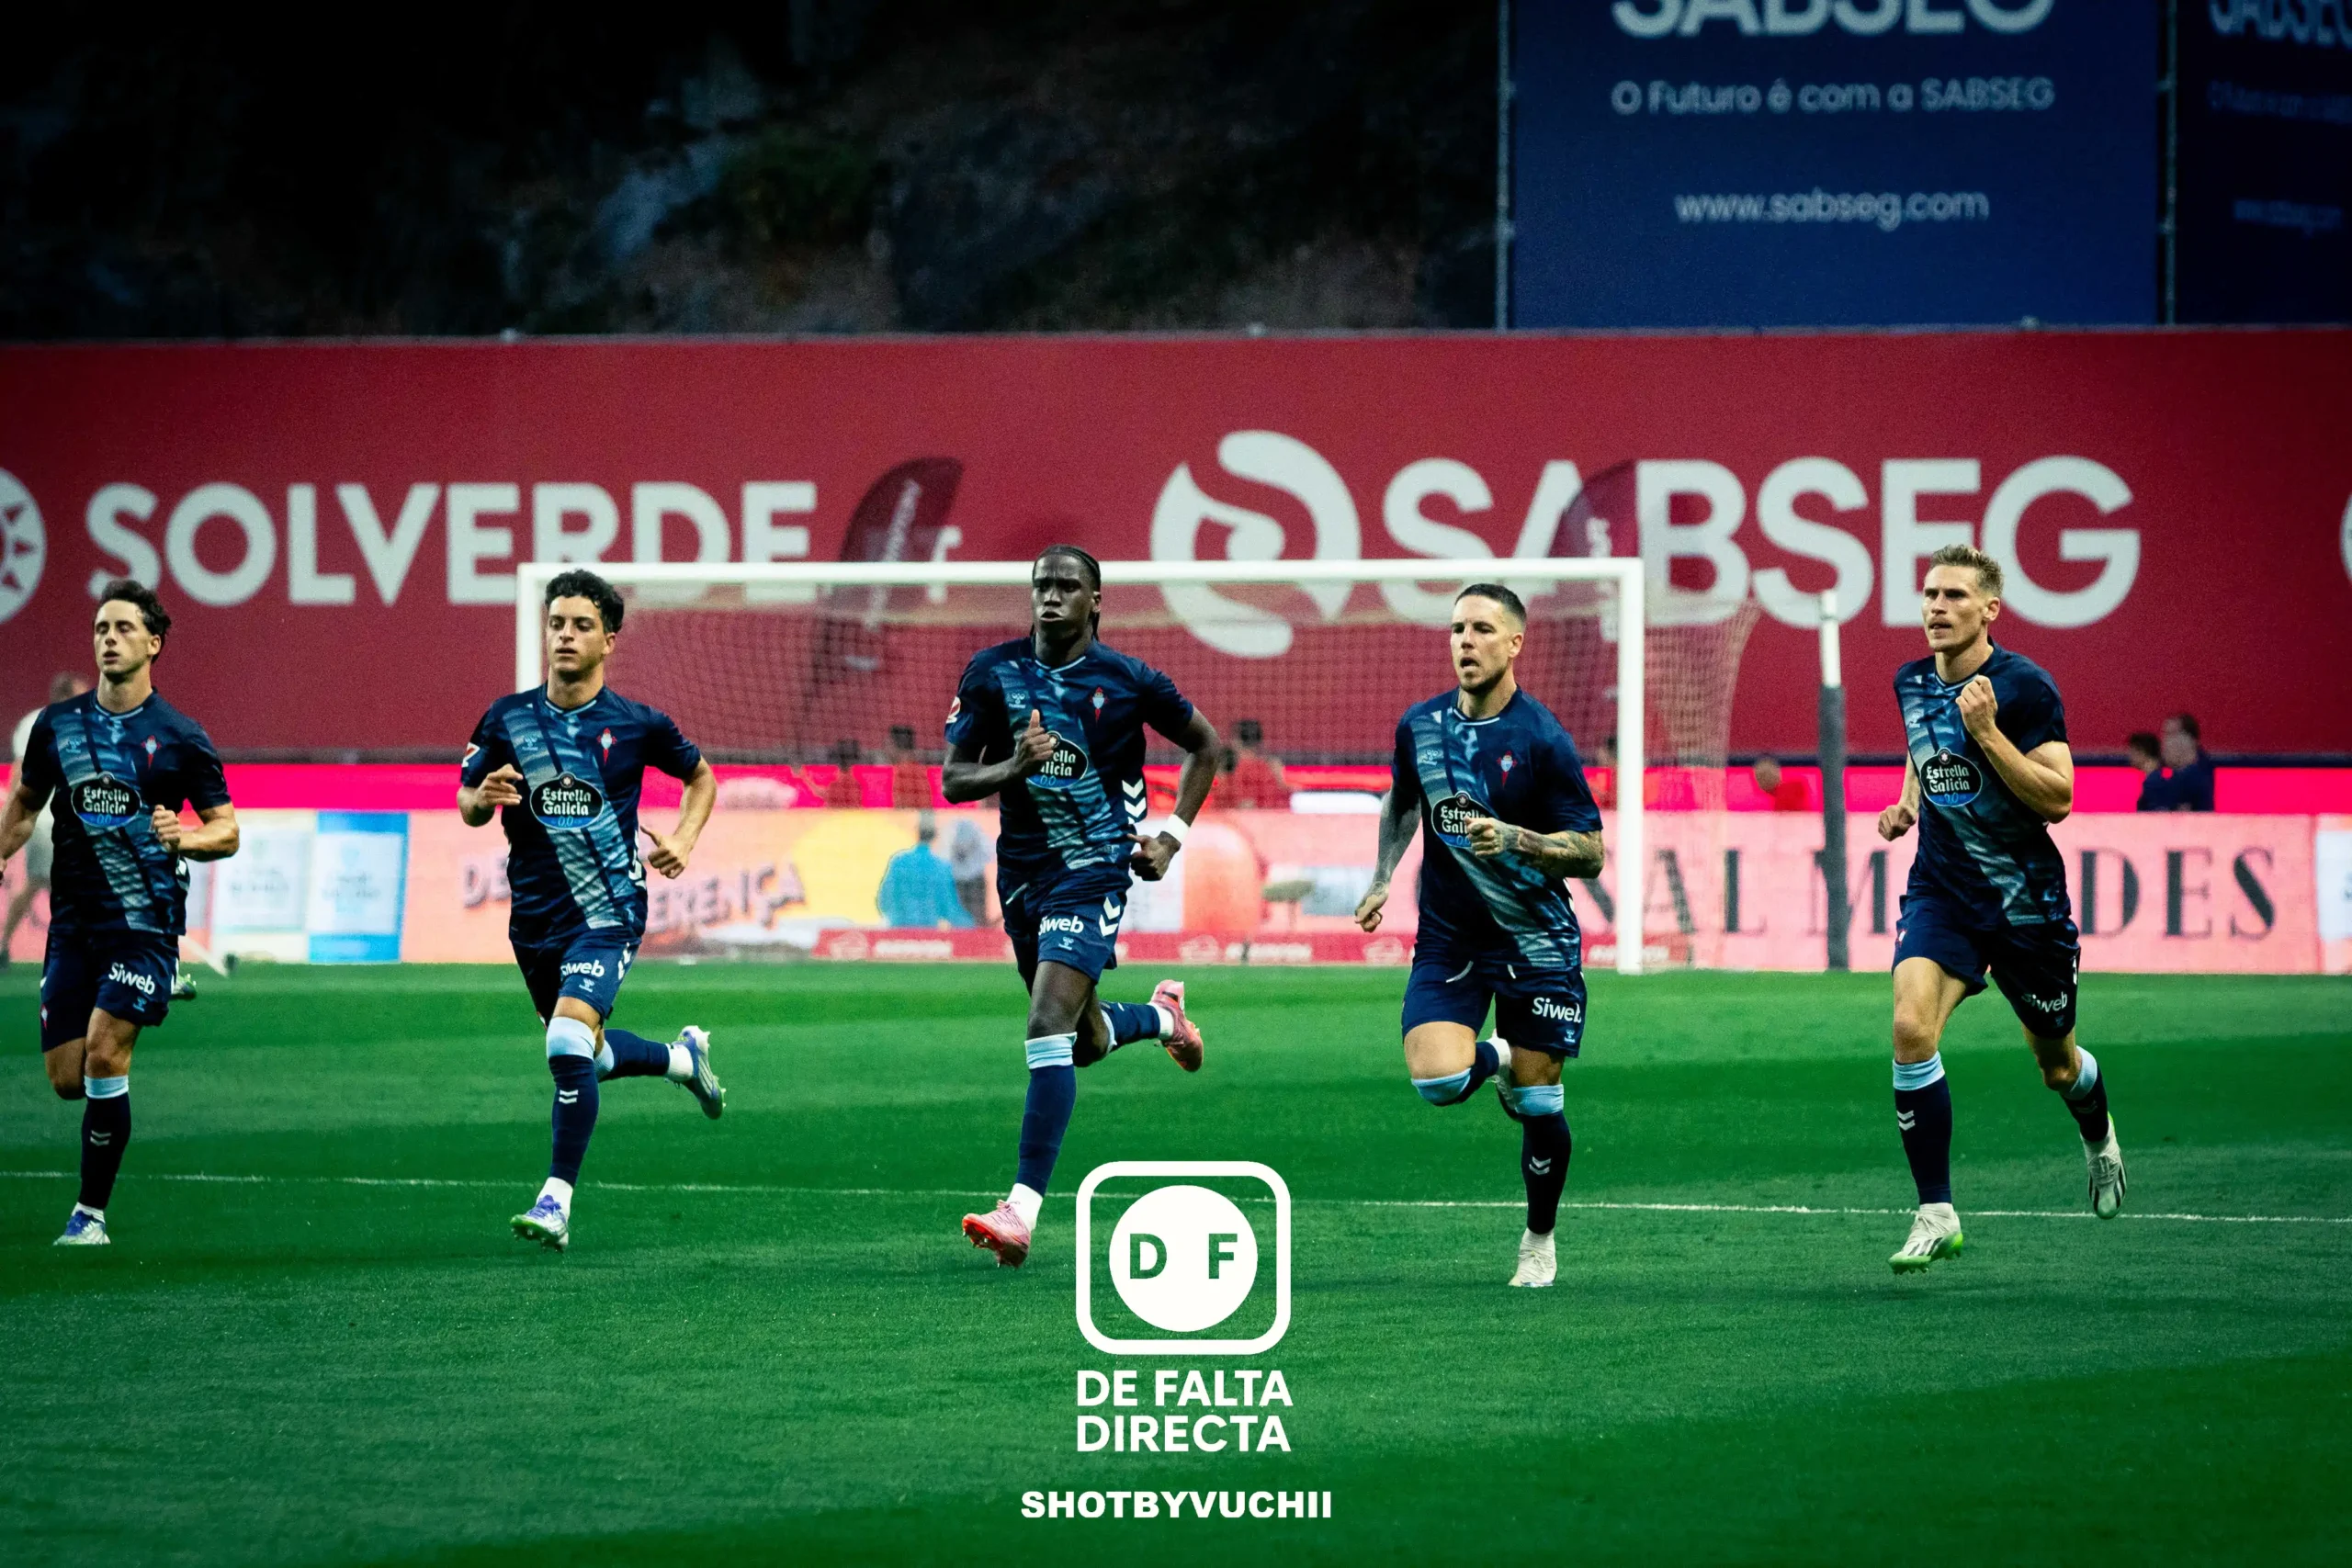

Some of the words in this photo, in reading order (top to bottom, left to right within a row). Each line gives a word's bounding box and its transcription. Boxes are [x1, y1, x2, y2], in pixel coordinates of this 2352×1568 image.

[1611, 80, 1643, 115] O
[1648, 79, 1762, 115] Futuro
[1798, 83, 1881, 114] com
[1886, 84, 1914, 113] a
[1920, 76, 2056, 113] SABSEG
[1675, 189, 1989, 231] www.sabseg.com
[1040, 761, 1072, 776] licia
[1927, 764, 1970, 780] Estrella
[1929, 777, 1970, 793] Galicia
[83, 785, 130, 803] Estrella
[541, 787, 591, 803] Estrella
[83, 797, 127, 815] Galicia
[542, 800, 589, 816] Galicia
[1442, 819, 1467, 834] Gali
[1810, 847, 2276, 941] MDES
[108, 962, 155, 995] Siweb
